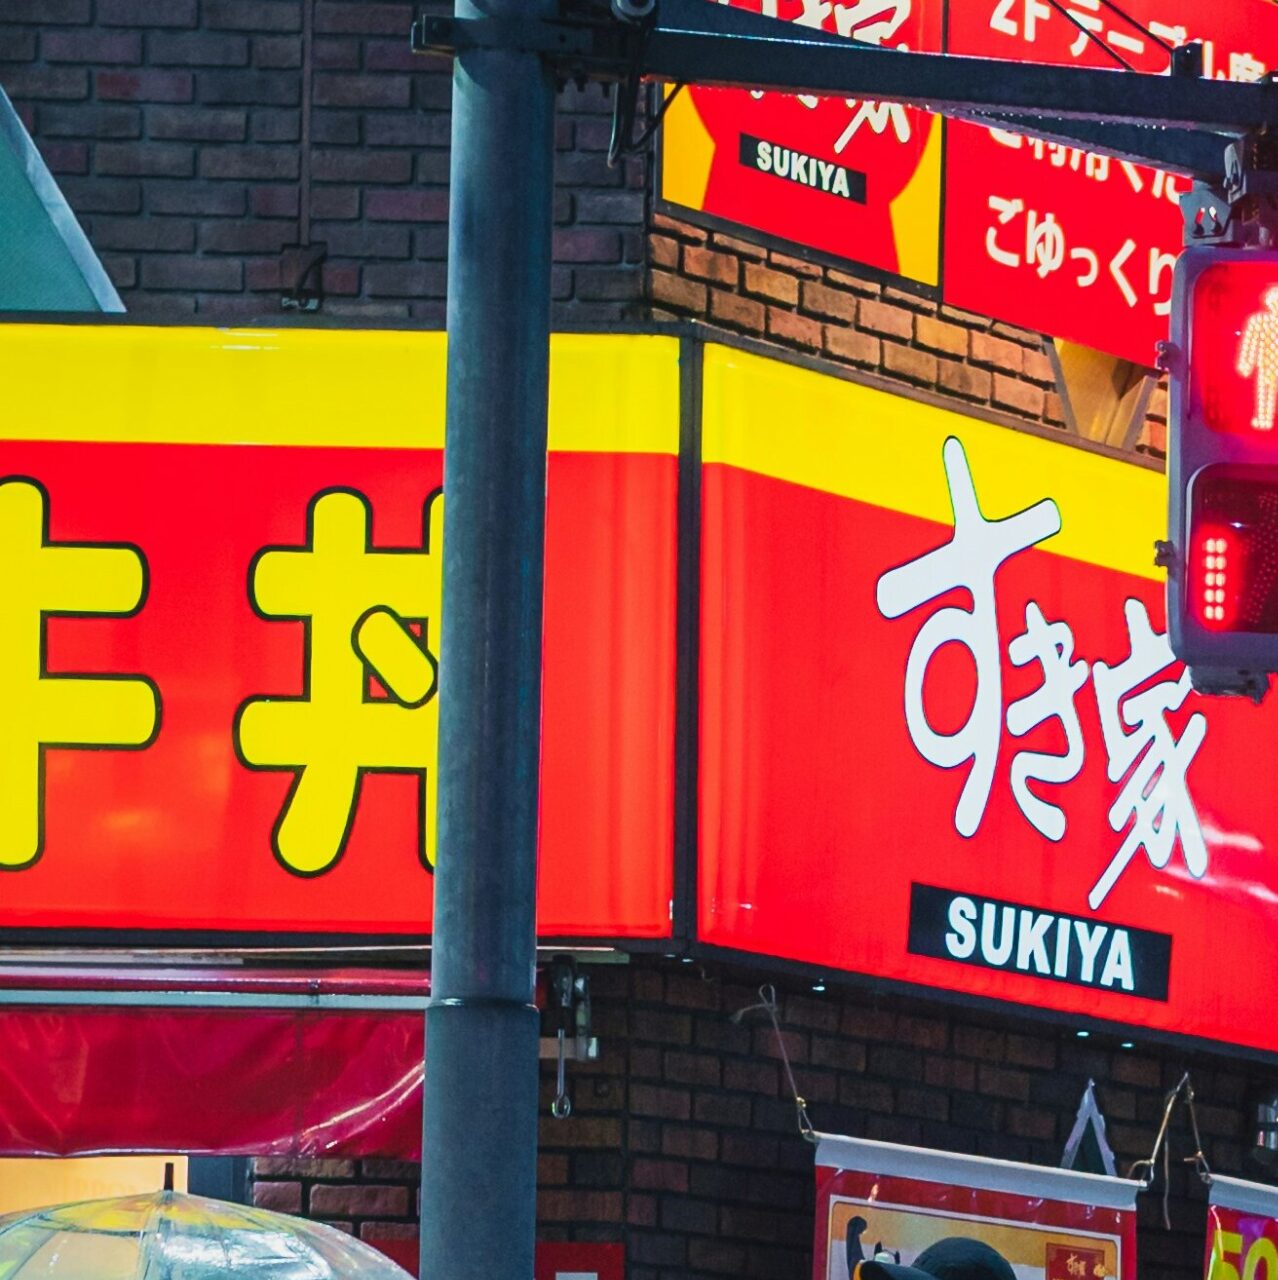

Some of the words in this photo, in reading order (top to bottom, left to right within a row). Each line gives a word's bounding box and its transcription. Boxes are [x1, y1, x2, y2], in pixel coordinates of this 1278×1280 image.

[756, 140, 850, 198] SUKIYA
[875, 435, 1207, 911] すき家
[944, 894, 1136, 990] SUKIYA
